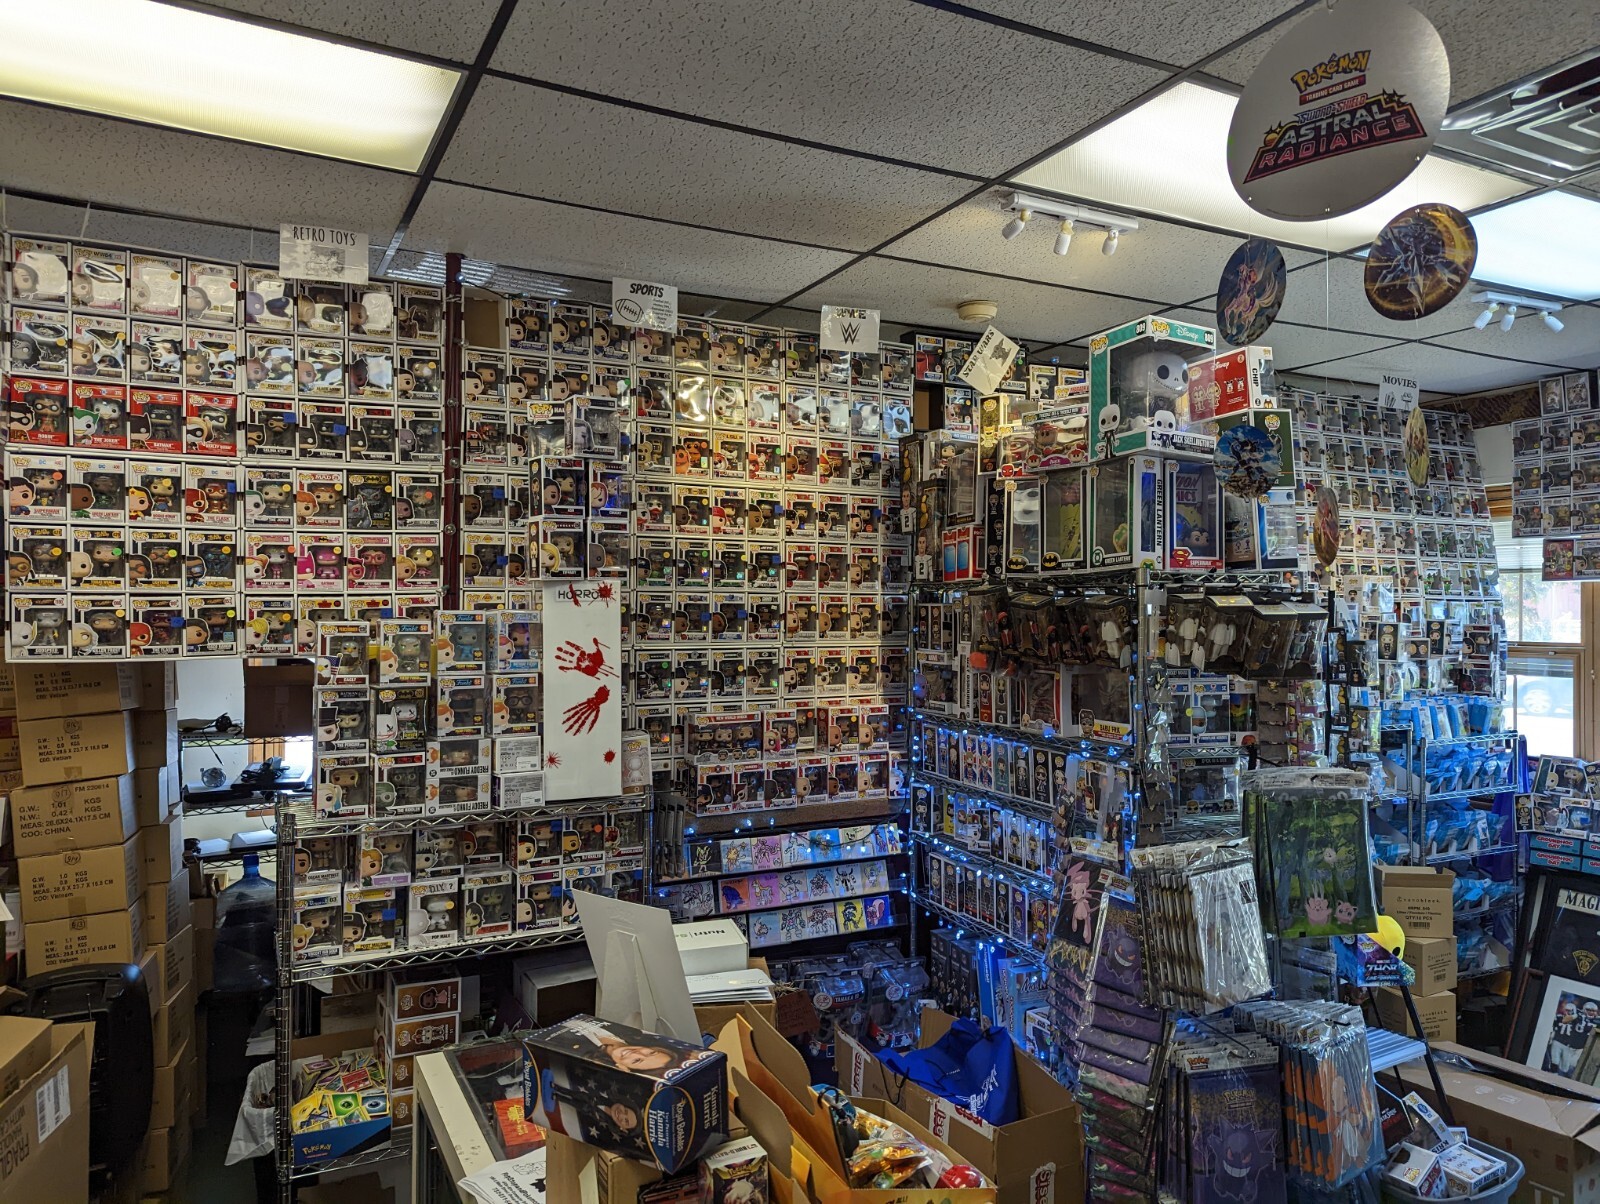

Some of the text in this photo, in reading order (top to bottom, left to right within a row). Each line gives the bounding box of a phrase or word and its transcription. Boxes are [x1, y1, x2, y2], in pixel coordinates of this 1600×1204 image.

[1291, 50, 1371, 92] Pokémon
[1306, 79, 1360, 101] TRADING CARD GAME
[1279, 104, 1391, 148] ASTRAL
[1259, 114, 1411, 168] RADIANCE
[293, 226, 357, 246] RETRO TOYS
[630, 283, 664, 298] SPORTS
[835, 307, 867, 319] WWE
[1152, 320, 1170, 334] POP!
[1175, 324, 1199, 342] Disney
[963, 354, 979, 378] STAR
[978, 329, 995, 355] WARS
[1382, 375, 1417, 389] MOVIES
[1173, 434, 1183, 444] JACK
[20, 822, 44, 830] MEAS:
[44, 826, 71, 835] CHINA
[703, 1092, 712, 1130] Harris
[711, 1086, 719, 1127] Kamala
[649, 1109, 658, 1143] Harris
[657, 1110, 666, 1147] Kamala
[302, 1143, 331, 1155] Pokémon
[1431, 1140, 1449, 1155] KRIS
